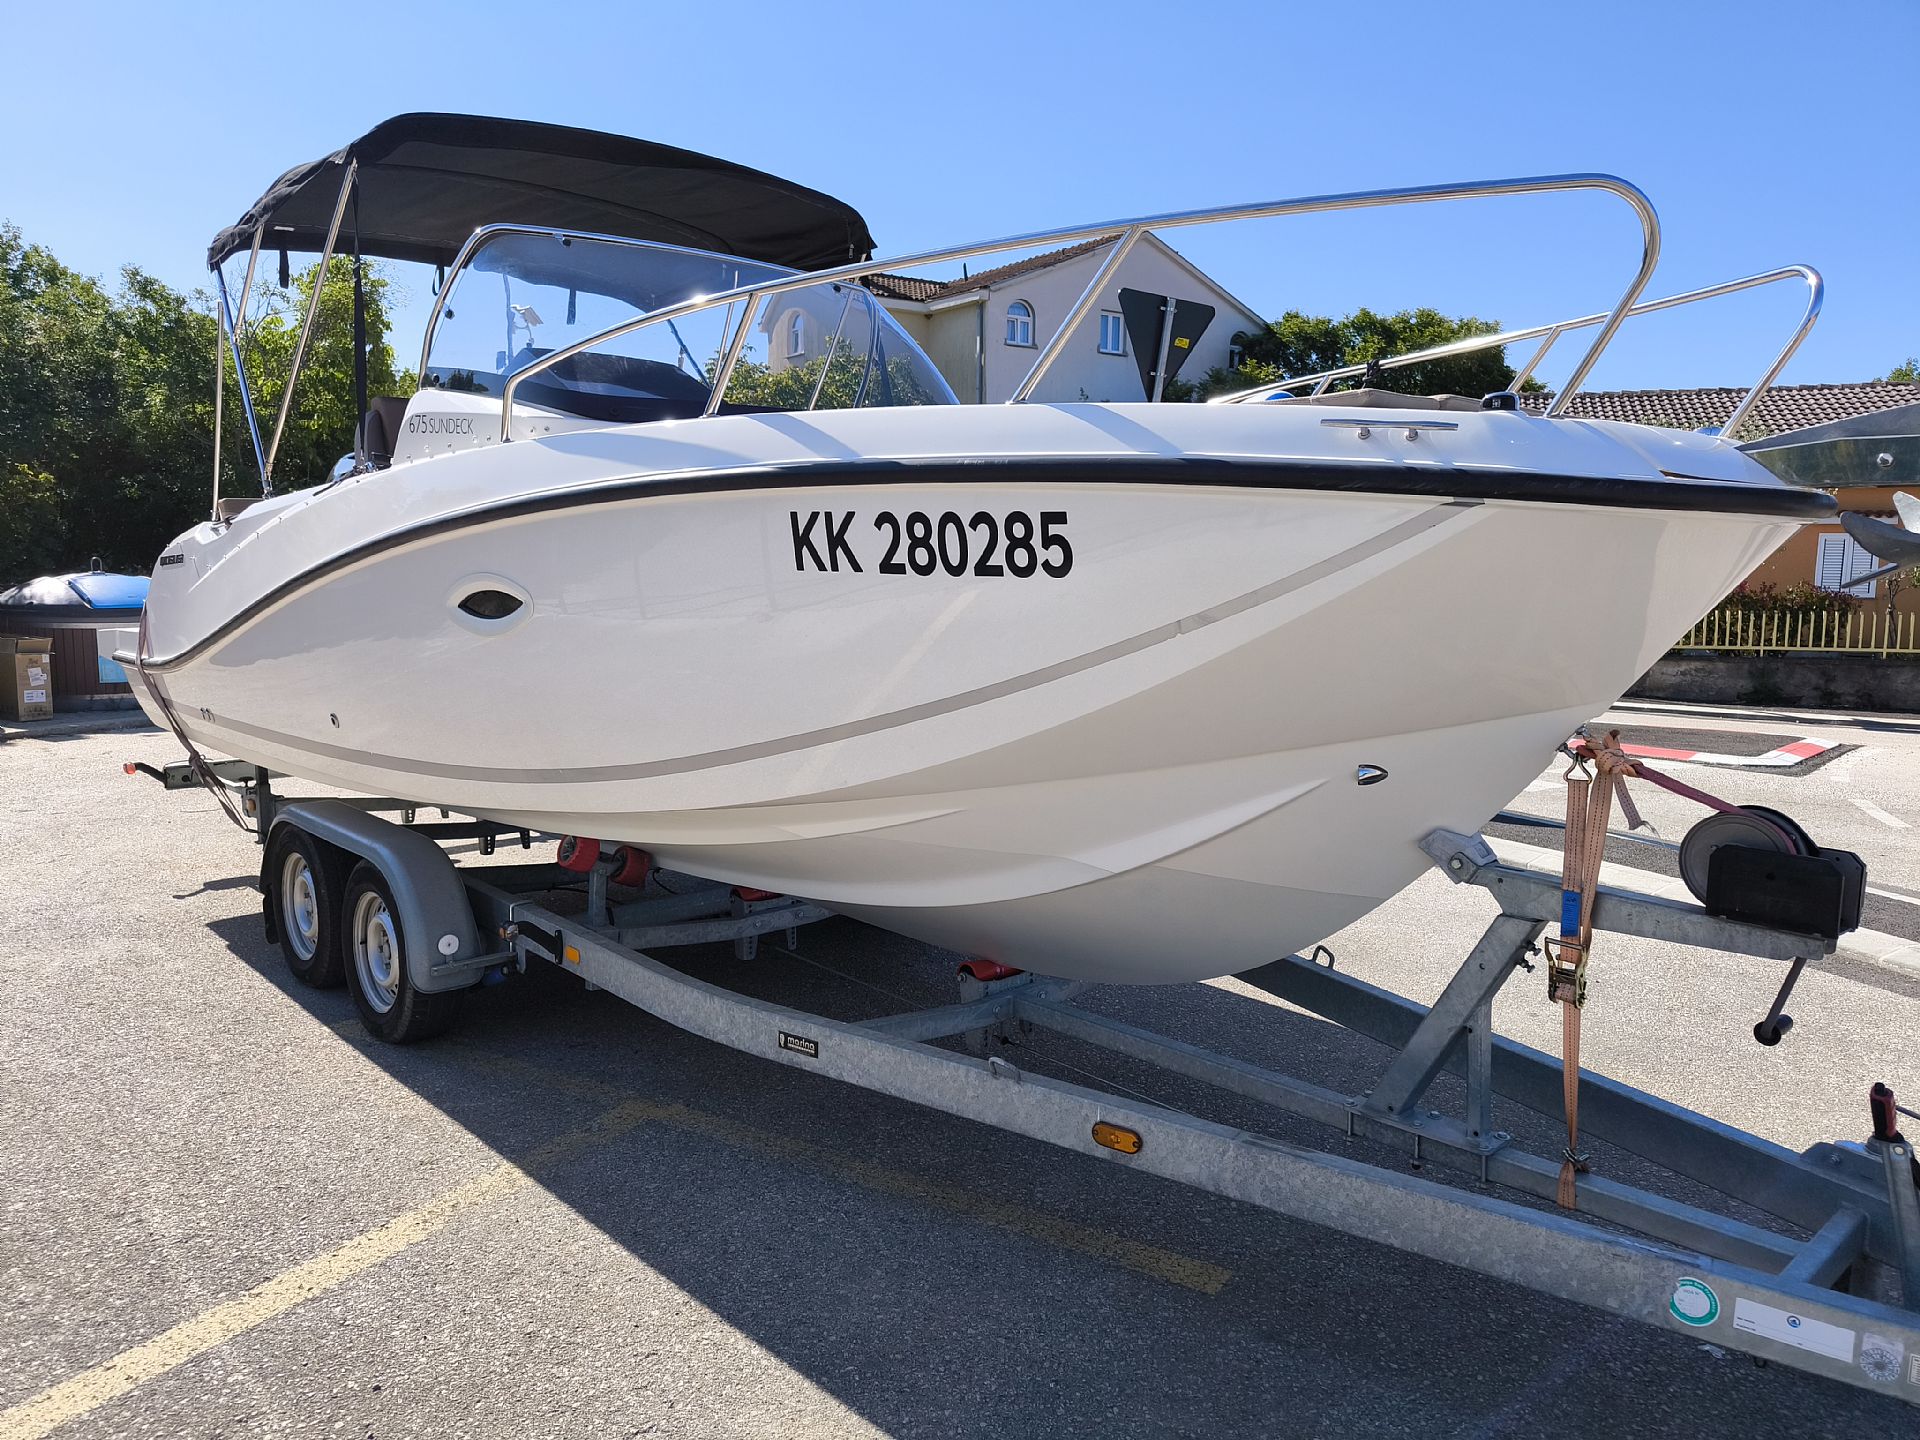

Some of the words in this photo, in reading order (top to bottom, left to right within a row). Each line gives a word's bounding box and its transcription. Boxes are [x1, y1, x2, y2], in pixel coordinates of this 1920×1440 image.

[409, 414, 428, 434] 675
[429, 417, 474, 435] SUNDECK
[789, 511, 864, 573] KK
[873, 510, 1074, 579] 280285
